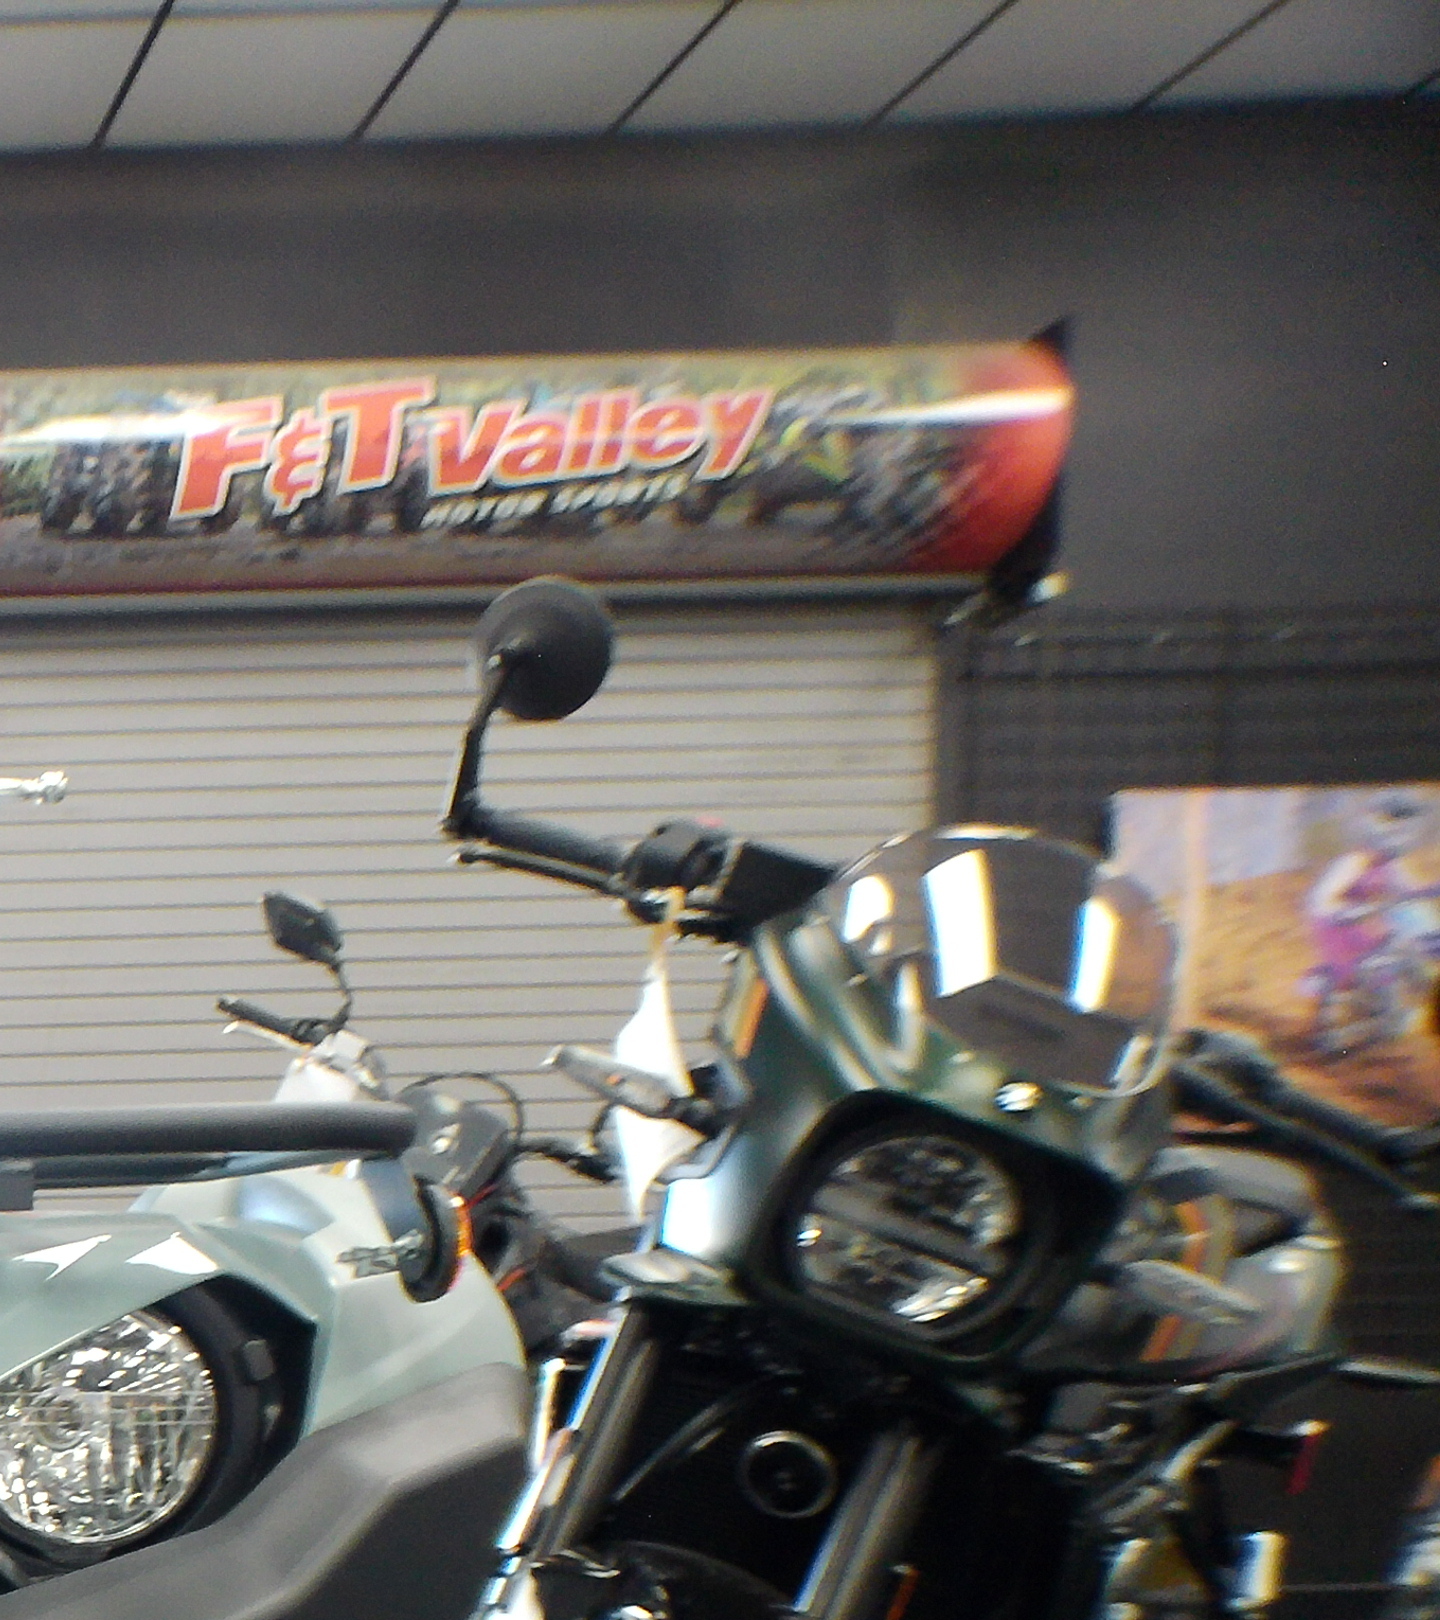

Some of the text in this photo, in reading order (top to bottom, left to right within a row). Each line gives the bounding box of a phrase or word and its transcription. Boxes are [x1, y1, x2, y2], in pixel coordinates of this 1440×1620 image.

[169, 376, 776, 520] F&T Valley
[419, 471, 690, 530] MOTOR SPORTS
